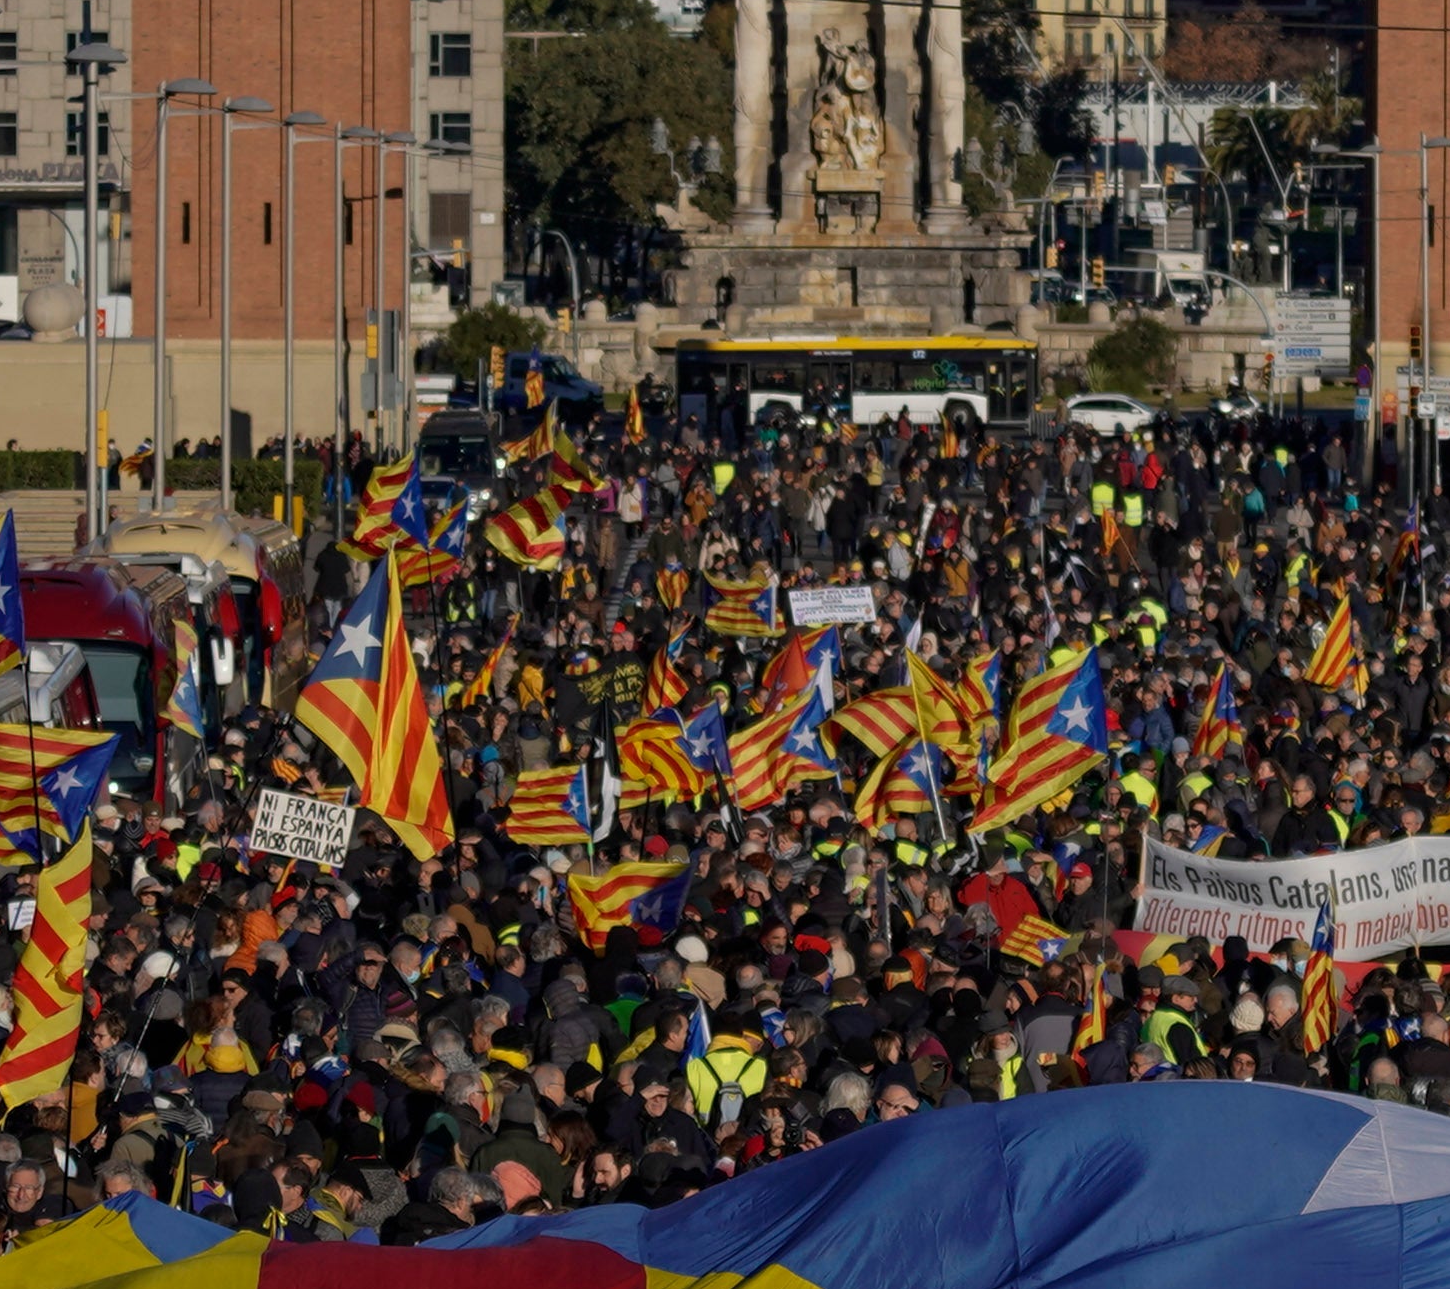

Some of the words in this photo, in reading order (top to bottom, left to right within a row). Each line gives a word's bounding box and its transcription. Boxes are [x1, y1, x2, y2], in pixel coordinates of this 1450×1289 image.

[286, 798, 347, 826] FRANÇA
[281, 815, 344, 844] ESPANYA
[290, 836, 346, 865] CATALANS
[1152, 855, 1183, 893] Els
[1185, 866, 1265, 907] Països
[1268, 869, 1390, 909] Catalans,
[1142, 897, 1229, 940] Diferents
[1355, 903, 1415, 950] mateix
